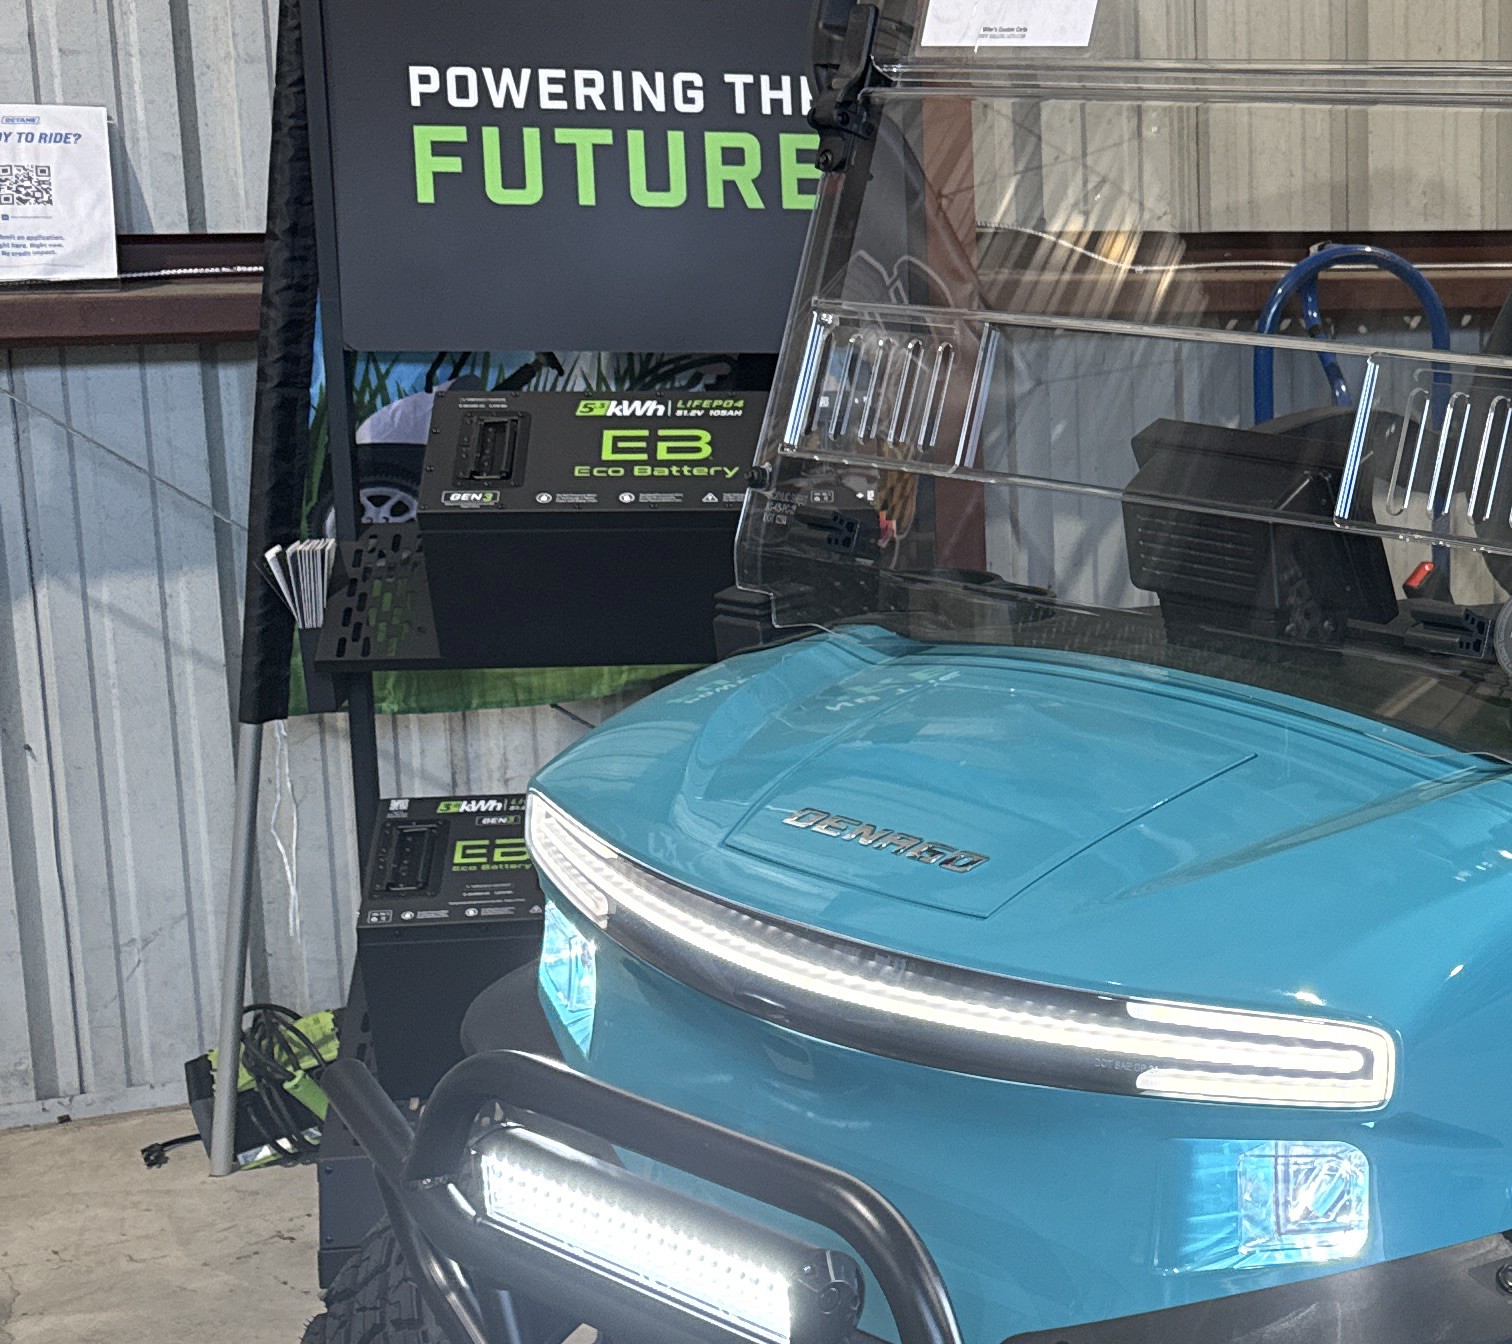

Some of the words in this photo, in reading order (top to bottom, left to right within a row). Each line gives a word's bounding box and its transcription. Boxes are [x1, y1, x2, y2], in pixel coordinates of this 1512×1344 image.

[408, 65, 705, 114] POWERING
[16, 132, 34, 144] TO
[38, 133, 82, 145] RIDE?
[412, 125, 819, 209] FUTURE
[677, 400, 745, 408] LIFEPO4
[601, 429, 712, 461] EB
[574, 466, 625, 477] Eco
[634, 465, 739, 479] Battery
[450, 493, 493, 502] GEN3
[782, 807, 990, 874] DENAGO
